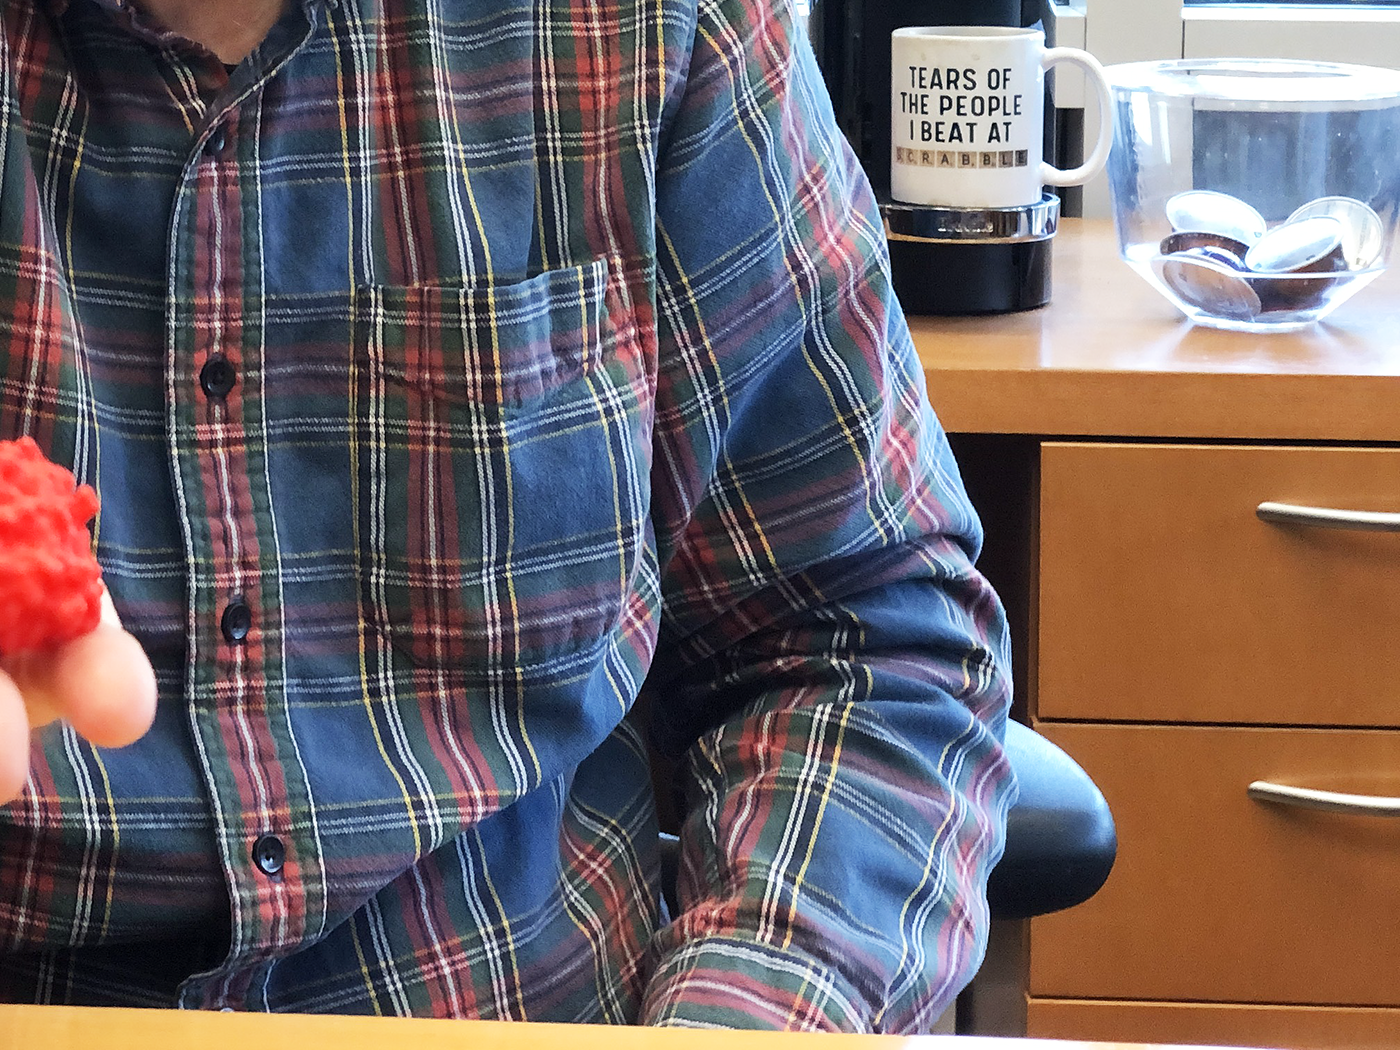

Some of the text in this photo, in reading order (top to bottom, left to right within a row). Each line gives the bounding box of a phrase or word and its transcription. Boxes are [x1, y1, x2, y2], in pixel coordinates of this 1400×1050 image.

[909, 66, 1012, 91] TEARS OF
[900, 92, 1022, 117] THE PEOPLE
[910, 119, 1012, 143] I BEAT AT
[896, 150, 1027, 167] SCRABBLE
